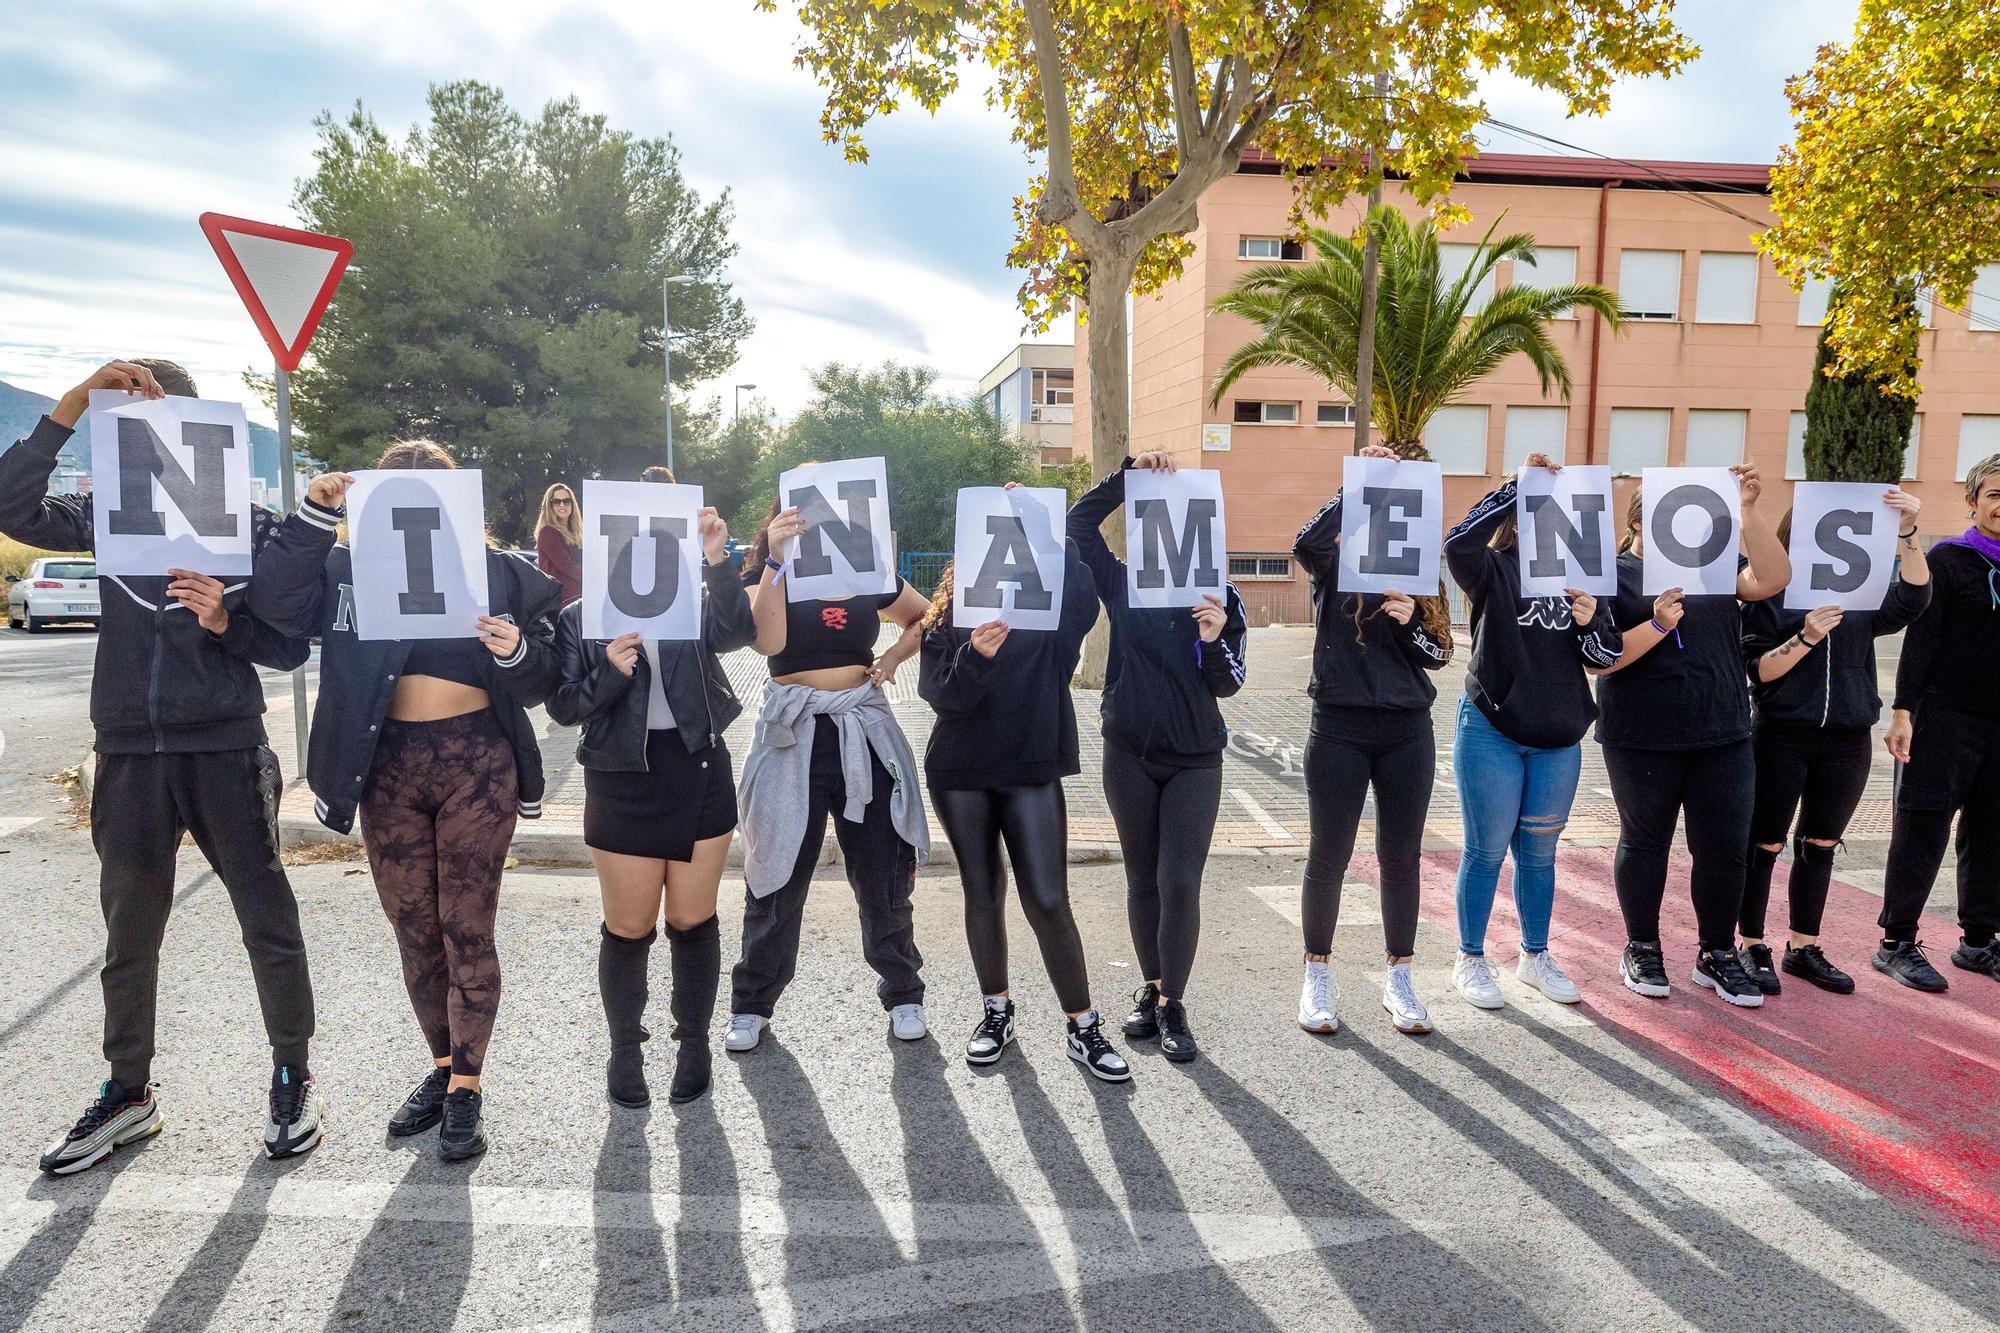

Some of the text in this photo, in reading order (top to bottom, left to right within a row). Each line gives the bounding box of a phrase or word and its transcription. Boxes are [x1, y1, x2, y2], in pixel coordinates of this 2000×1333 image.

[109, 417, 238, 537] N
[392, 507, 446, 615] I
[600, 515, 688, 618] U
[788, 479, 876, 578] N
[964, 515, 1053, 611] A
[1135, 498, 1219, 589] M
[1359, 486, 1423, 577] E
[1526, 493, 1606, 578] N
[1651, 484, 1732, 568] O
[1810, 509, 1873, 593] S
